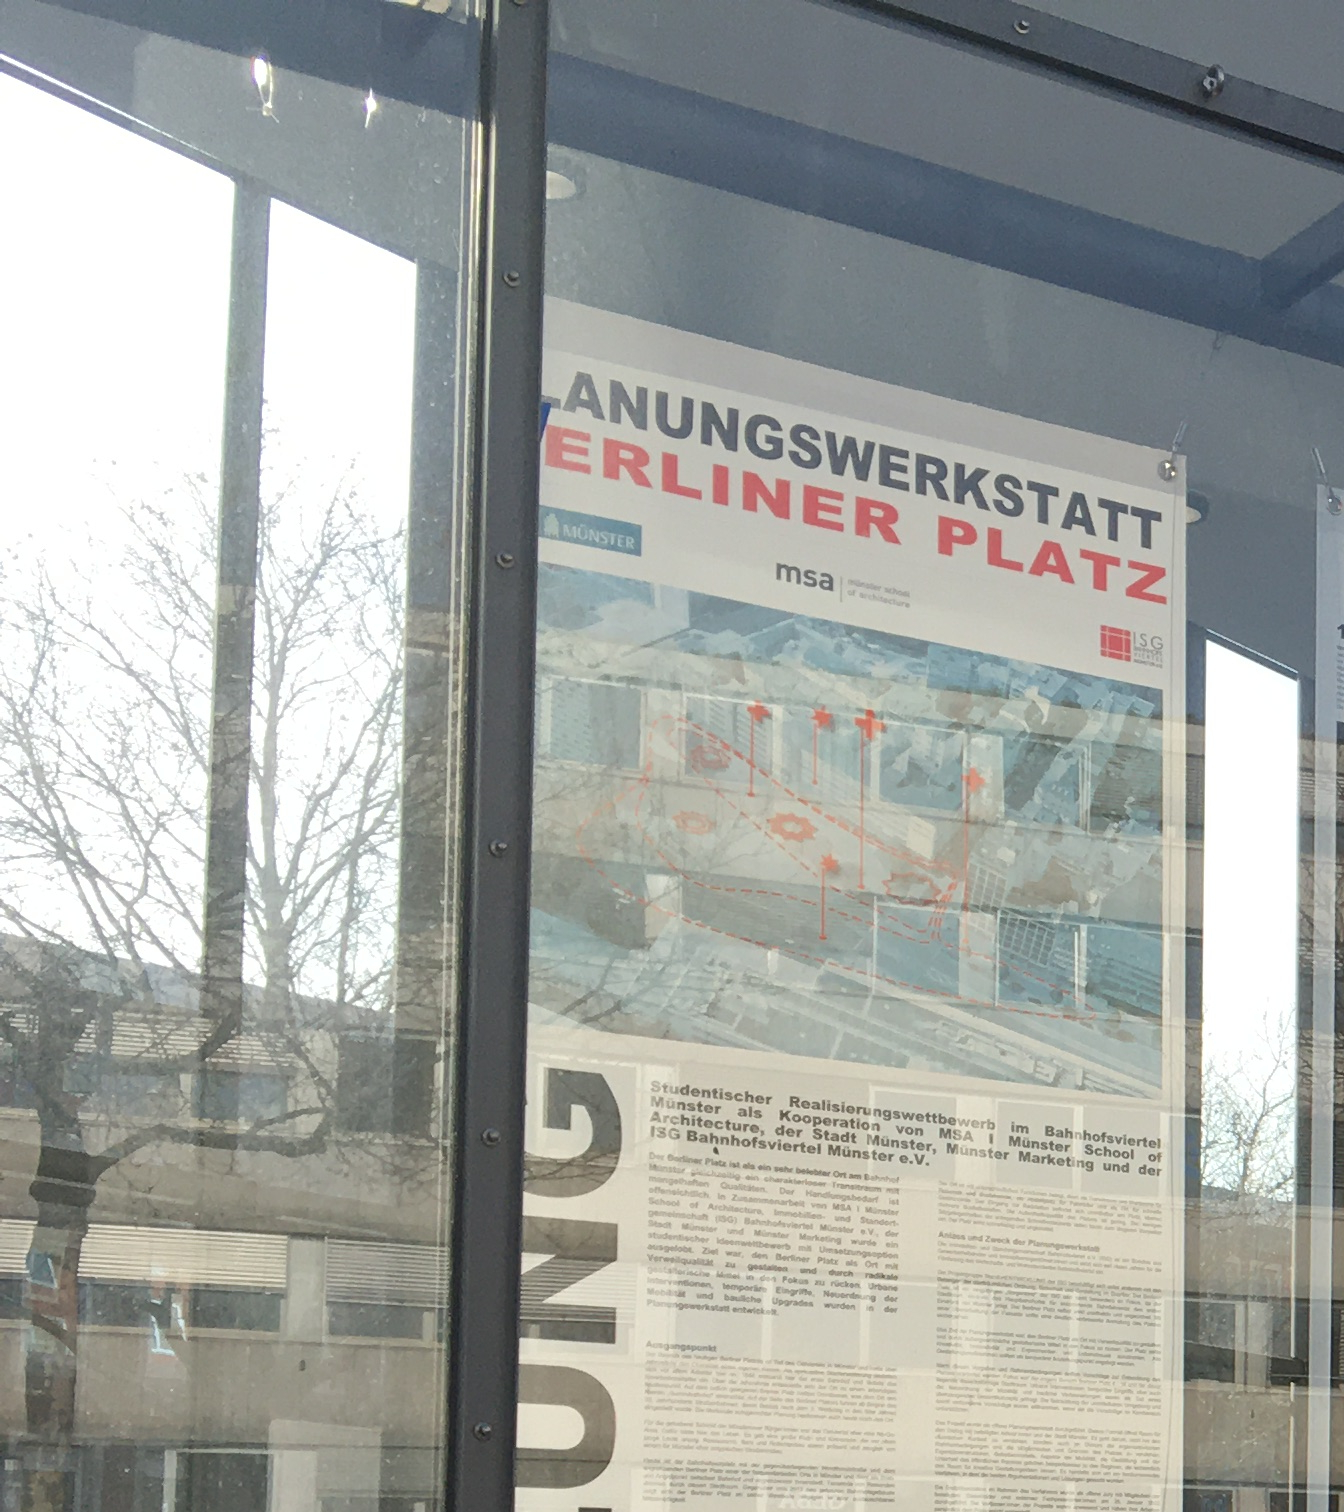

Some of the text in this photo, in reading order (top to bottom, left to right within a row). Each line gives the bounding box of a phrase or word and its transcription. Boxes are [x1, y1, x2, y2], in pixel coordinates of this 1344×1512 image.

[541, 370, 1162, 549] ANUNGSWERKSTATT
[562, 522, 635, 549] MÜNSTER
[937, 514, 1168, 605] PLATZ
[775, 561, 834, 592] msa
[649, 1111, 1162, 1176] Architecture, der Stadt Münster, Münster Marketing und der
[650, 1096, 721, 1115] Münster
[737, 1107, 762, 1119] als
[779, 1110, 881, 1132] Kooperation
[896, 1125, 924, 1137] von
[939, 1127, 974, 1142] MSA
[1008, 1135, 1071, 1152] Münster
[1084, 1143, 1134, 1159] School
[1147, 1150, 1162, 1162] of
[650, 1127, 930, 1166] ISG Bahnhofsviertel Münster e.V.
[651, 1082, 1161, 1148] Studentischer Realisierungswettbewerb im Bahnhofsviertel
